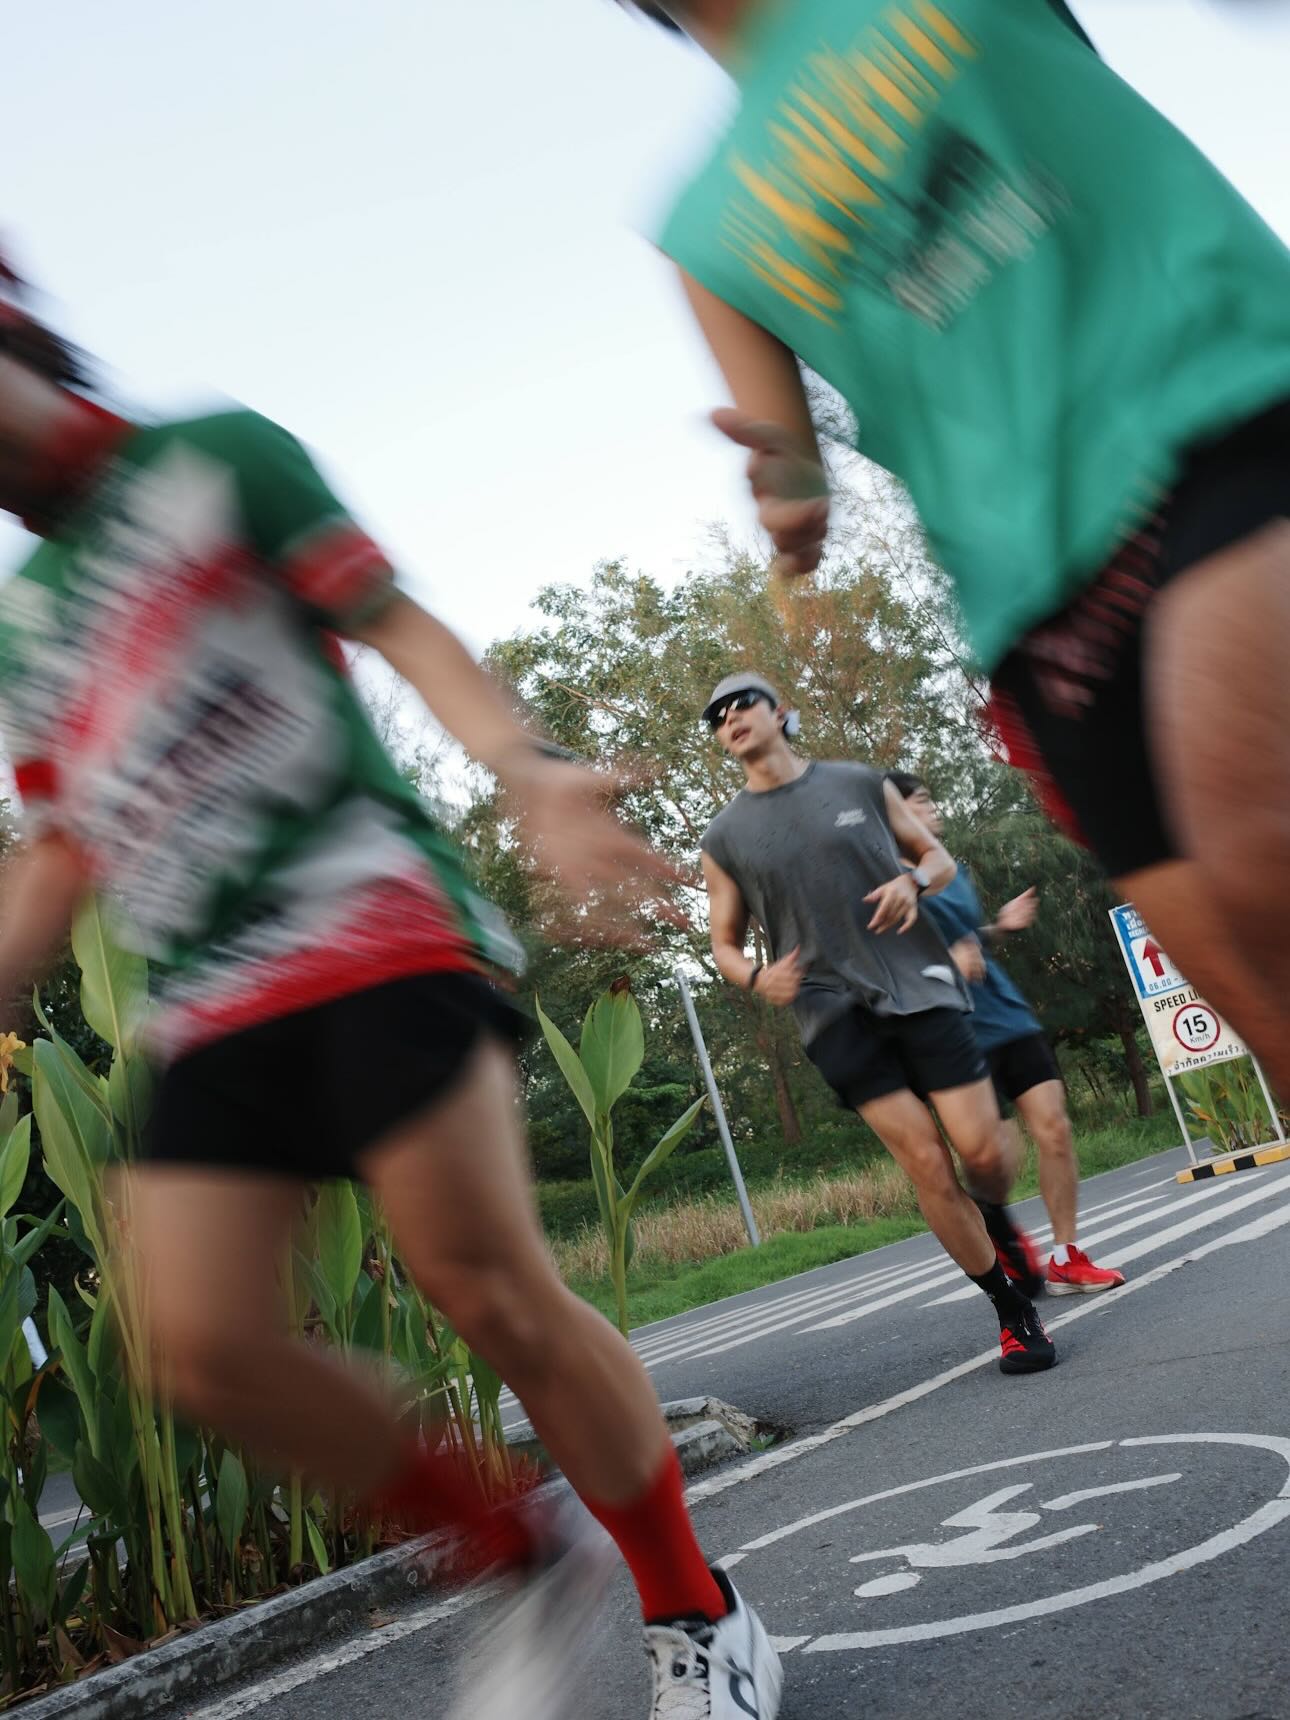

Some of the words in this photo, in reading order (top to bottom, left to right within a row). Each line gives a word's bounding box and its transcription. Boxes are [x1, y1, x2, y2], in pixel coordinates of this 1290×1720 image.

[1149, 978, 1172, 991] 06.00
[1153, 993, 1187, 1012] SPEED
[1188, 990, 1201, 1001] LI
[1183, 1013, 1207, 1036] 15
